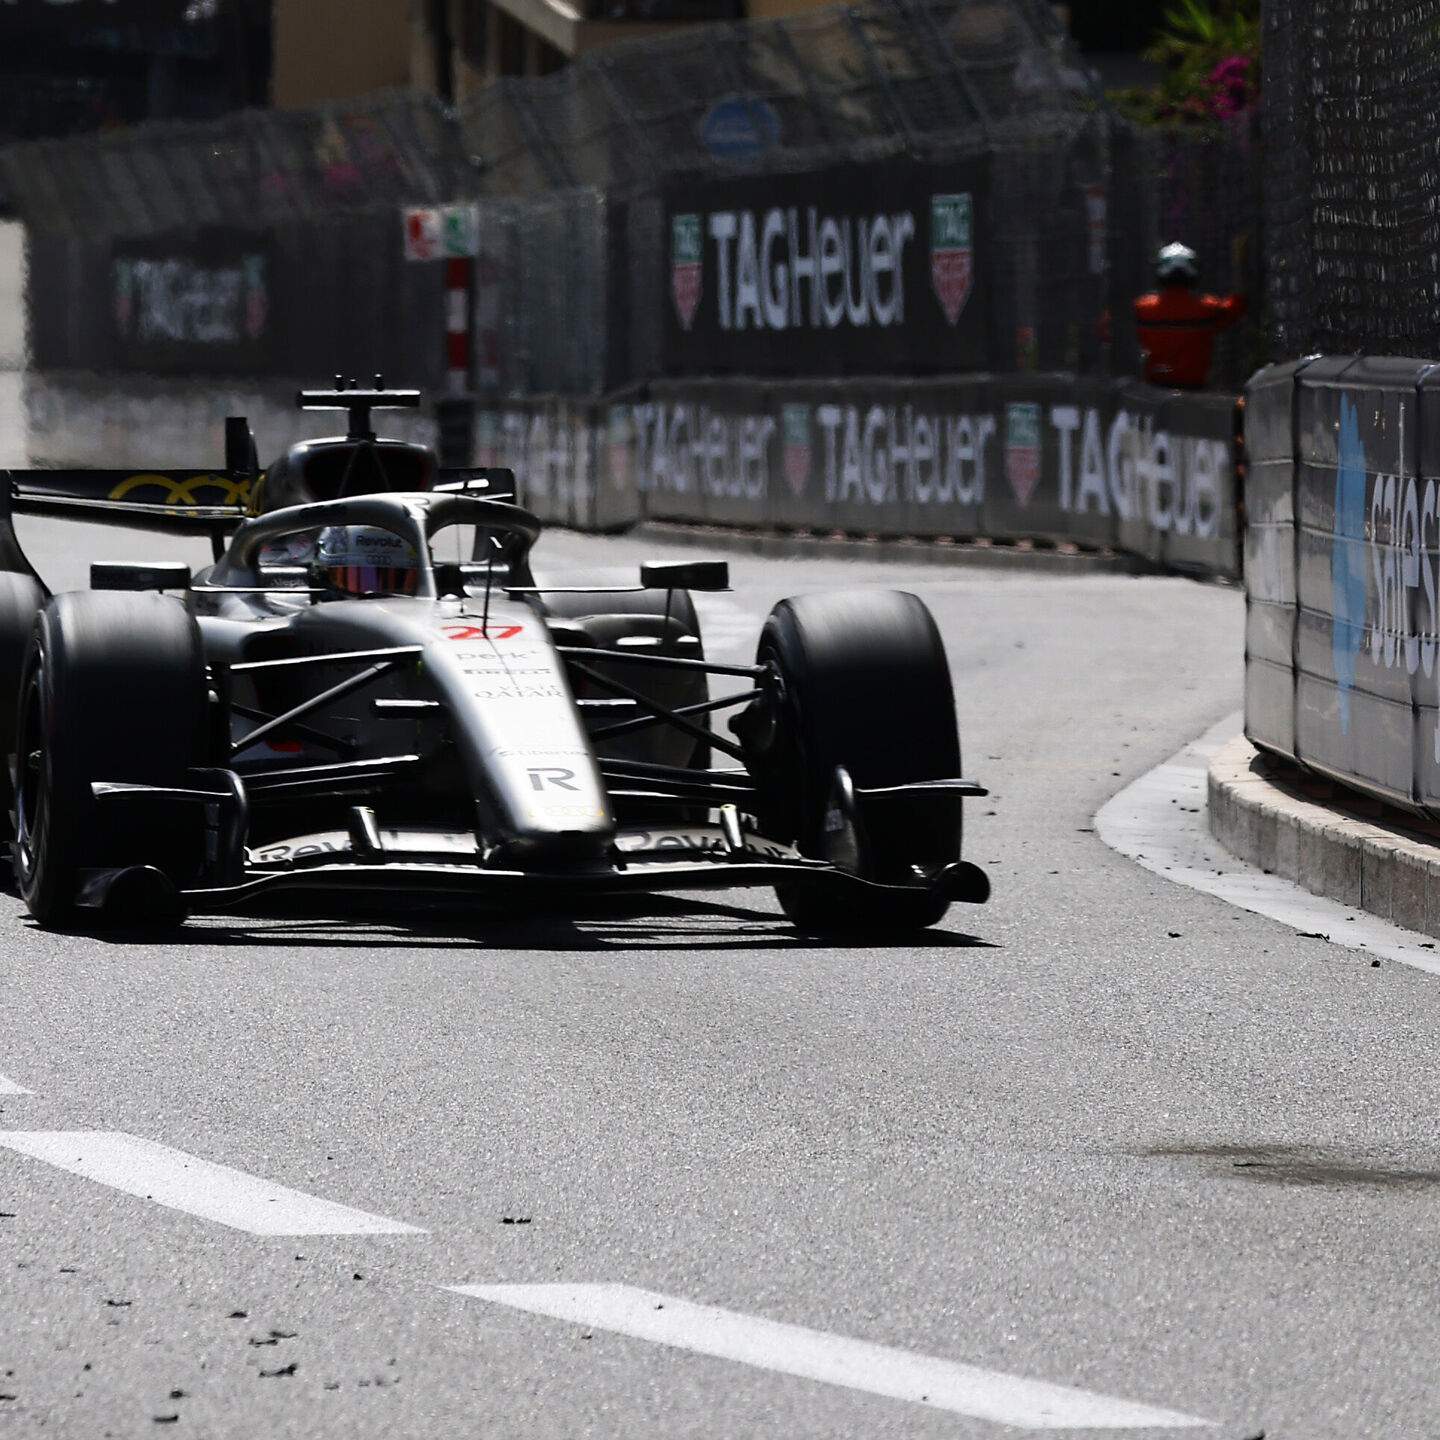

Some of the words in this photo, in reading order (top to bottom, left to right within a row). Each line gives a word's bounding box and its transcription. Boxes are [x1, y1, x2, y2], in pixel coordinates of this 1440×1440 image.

[708, 206, 915, 331] TAGHeuer
[817, 402, 996, 506] TAGHeuer
[1051, 405, 1230, 540] TAGHeuer
[355, 534, 404, 549] Revolut
[440, 625, 524, 640] 27
[526, 767, 582, 792] R
